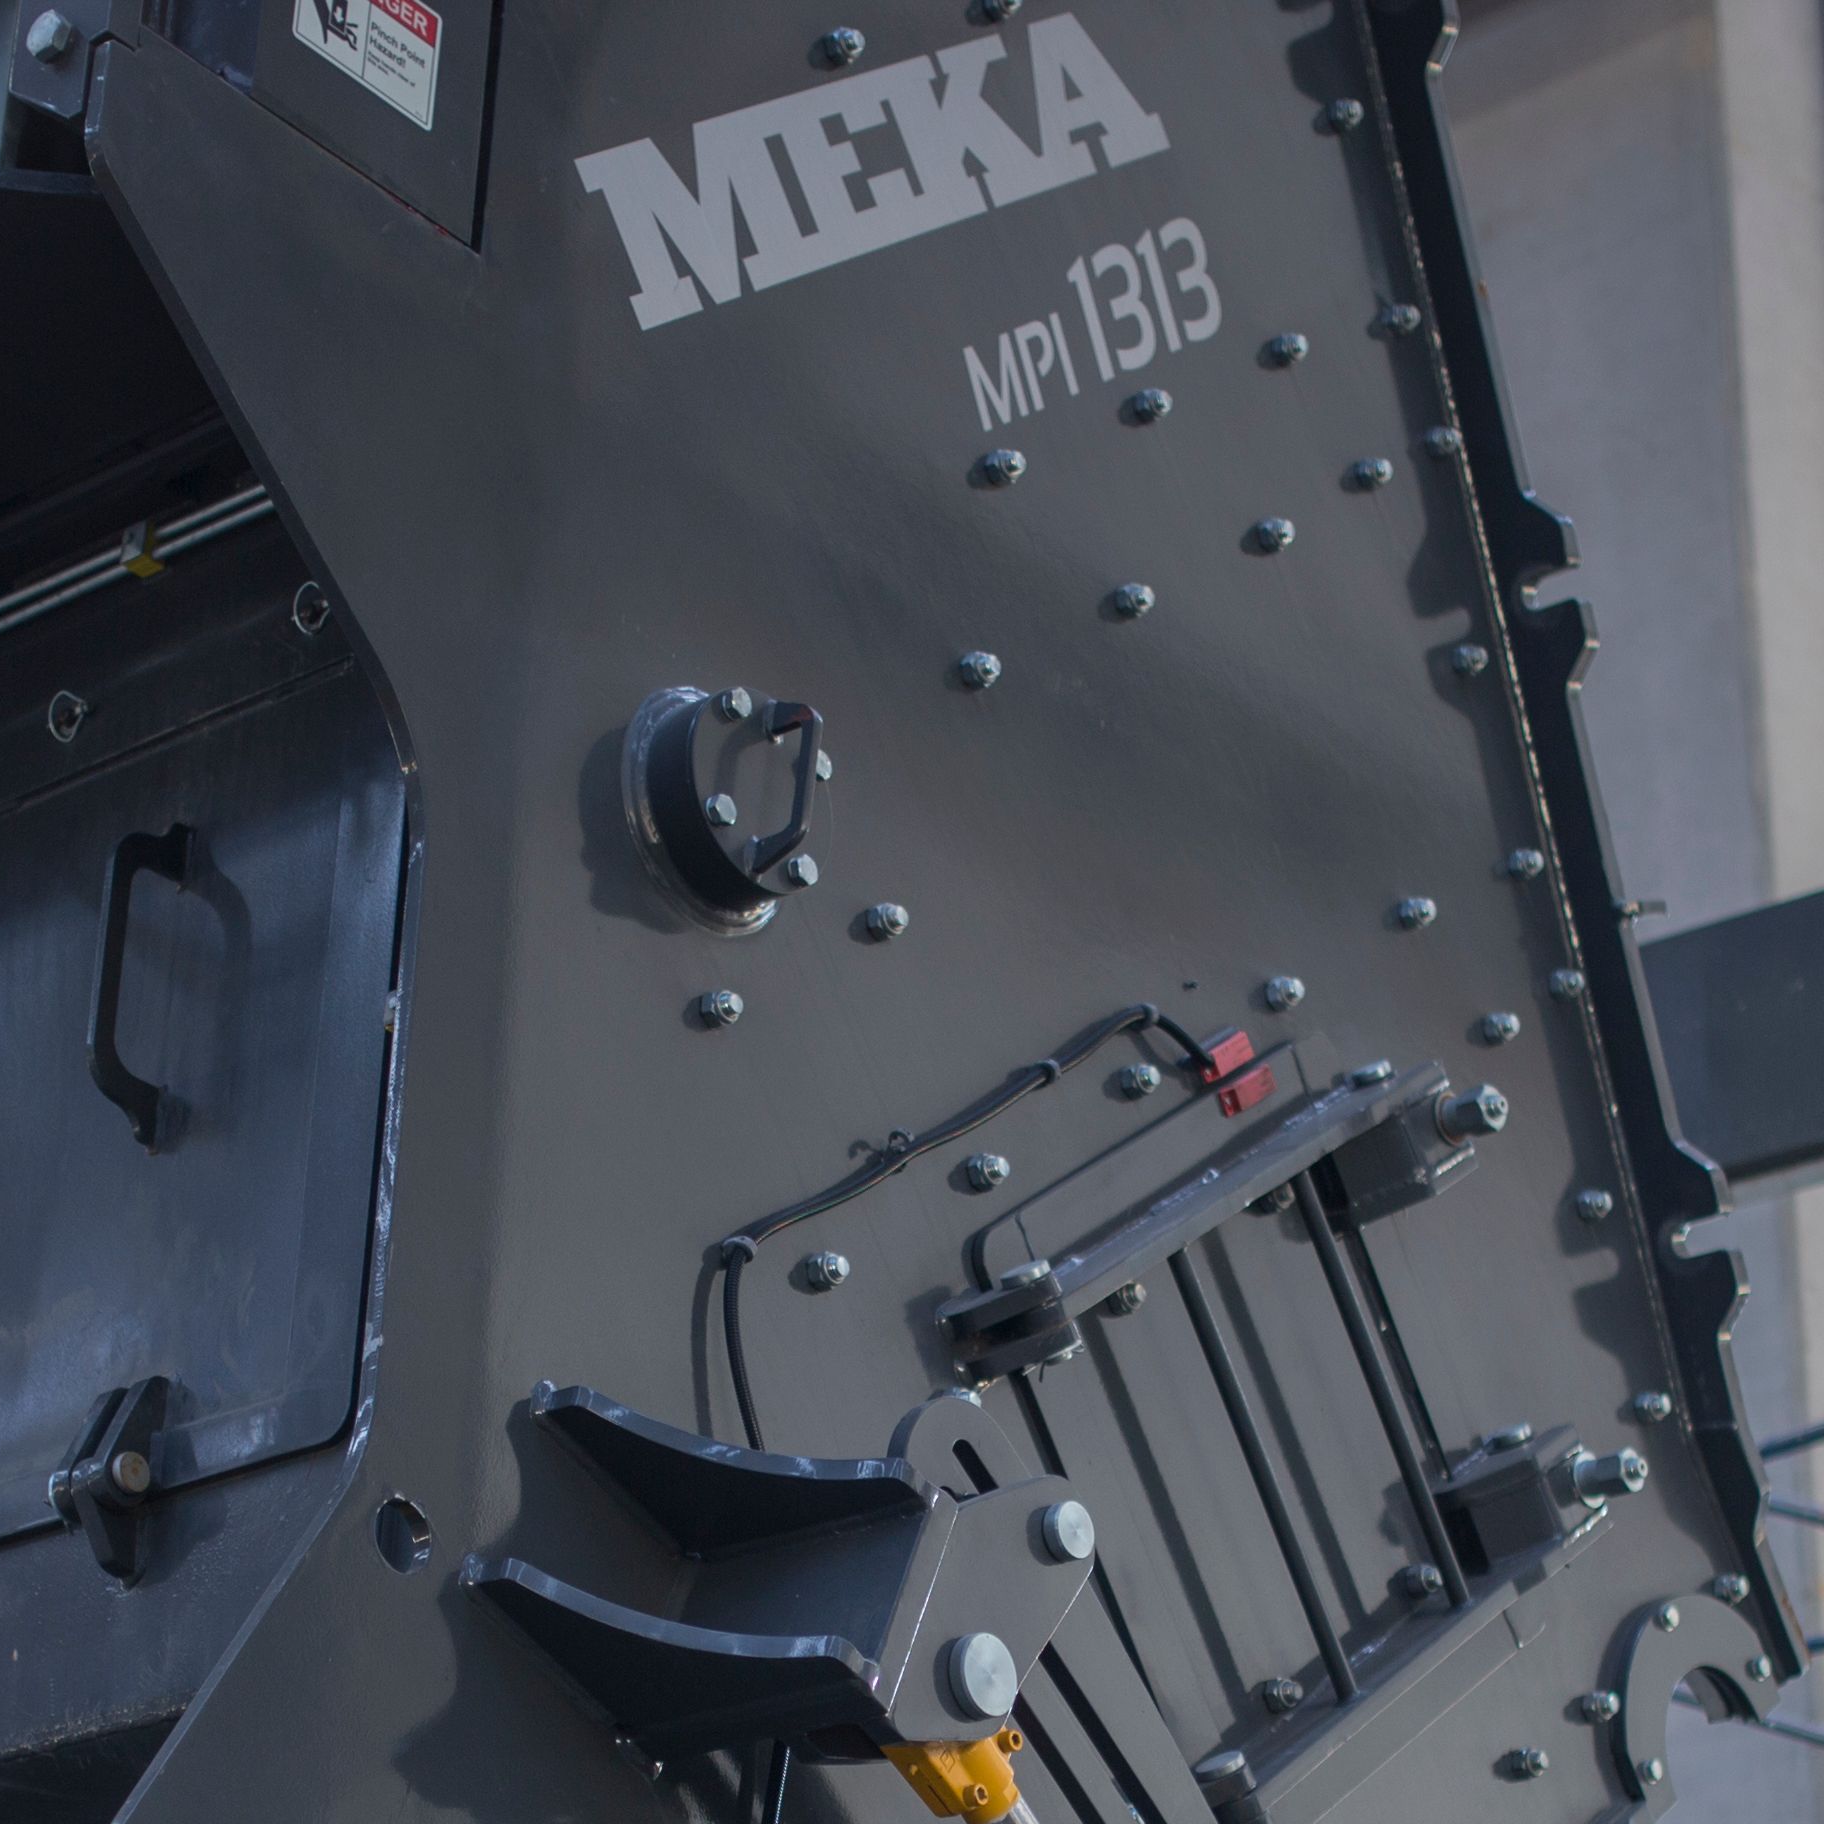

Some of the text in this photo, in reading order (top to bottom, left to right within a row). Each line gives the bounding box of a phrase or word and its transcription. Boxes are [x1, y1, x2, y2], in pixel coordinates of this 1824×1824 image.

[378, 0, 428, 37] GER
[574, 12, 1171, 331] MEKA
[962, 216, 1223, 432] MPI 1313
